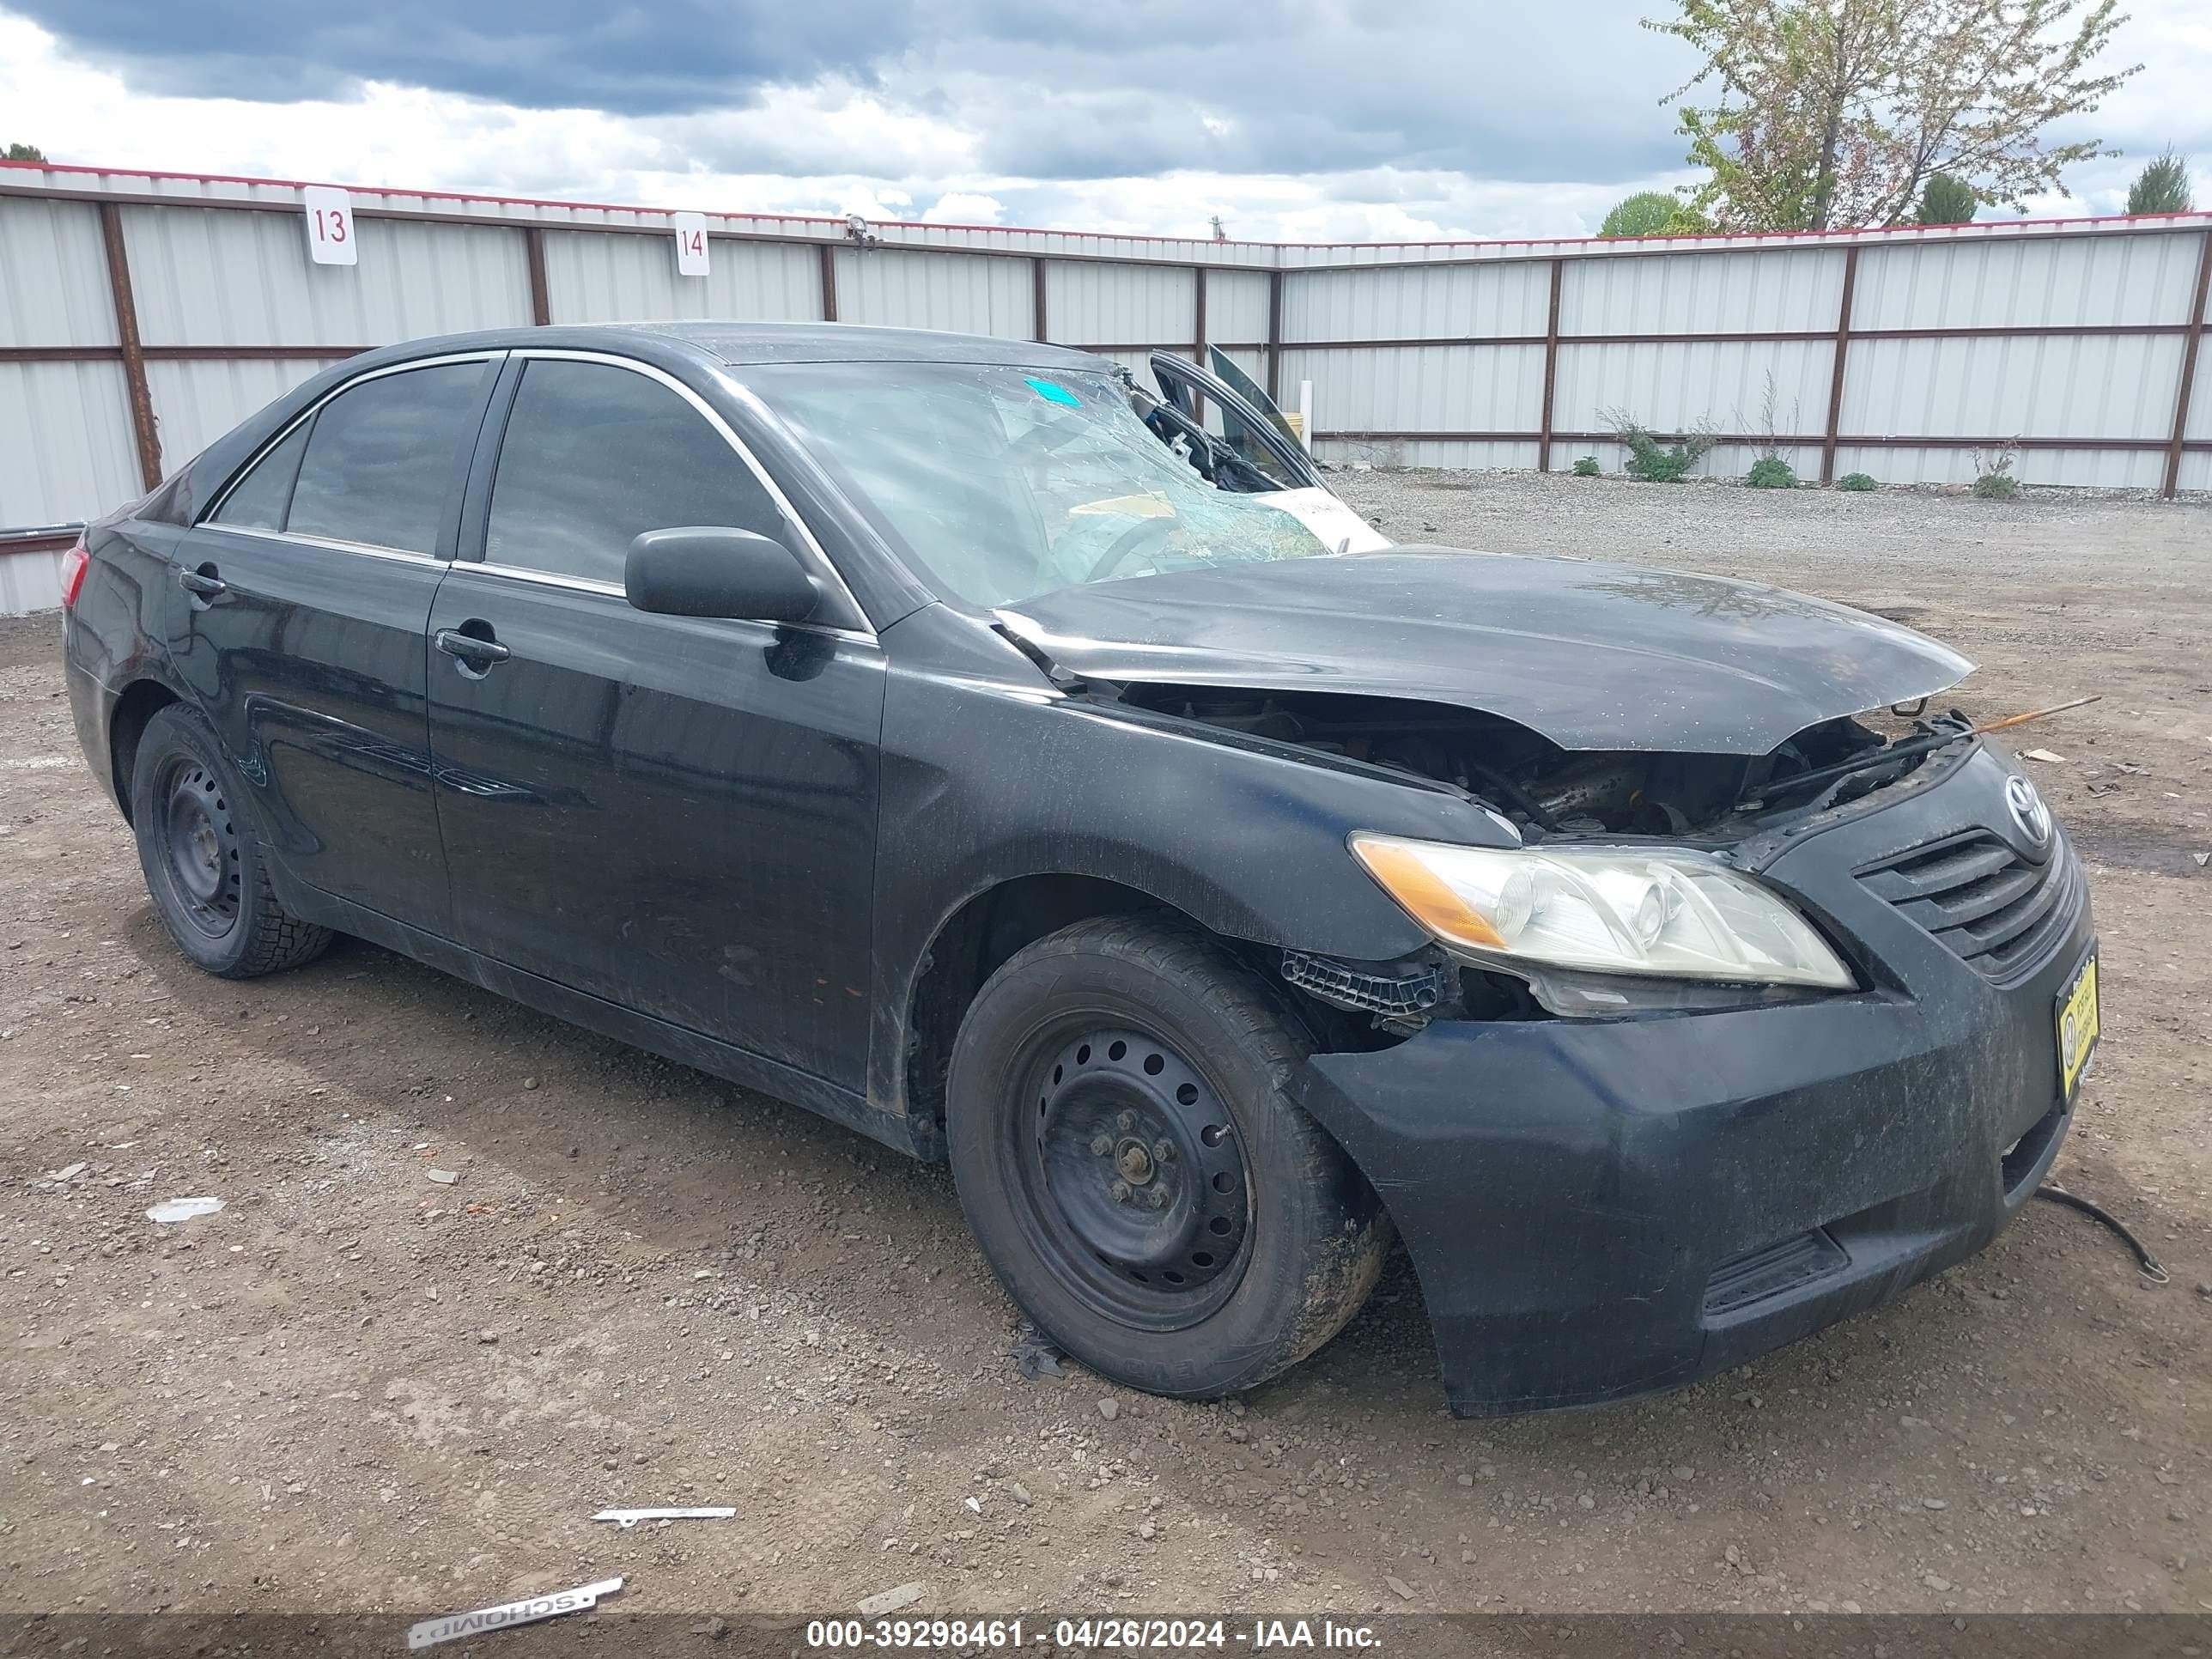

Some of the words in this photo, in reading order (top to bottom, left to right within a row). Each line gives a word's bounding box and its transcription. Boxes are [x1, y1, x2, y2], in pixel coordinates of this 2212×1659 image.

[315, 210, 346, 242] 13
[683, 230, 702, 256] 14
[429, 1595, 576, 1638] SCHOMP
